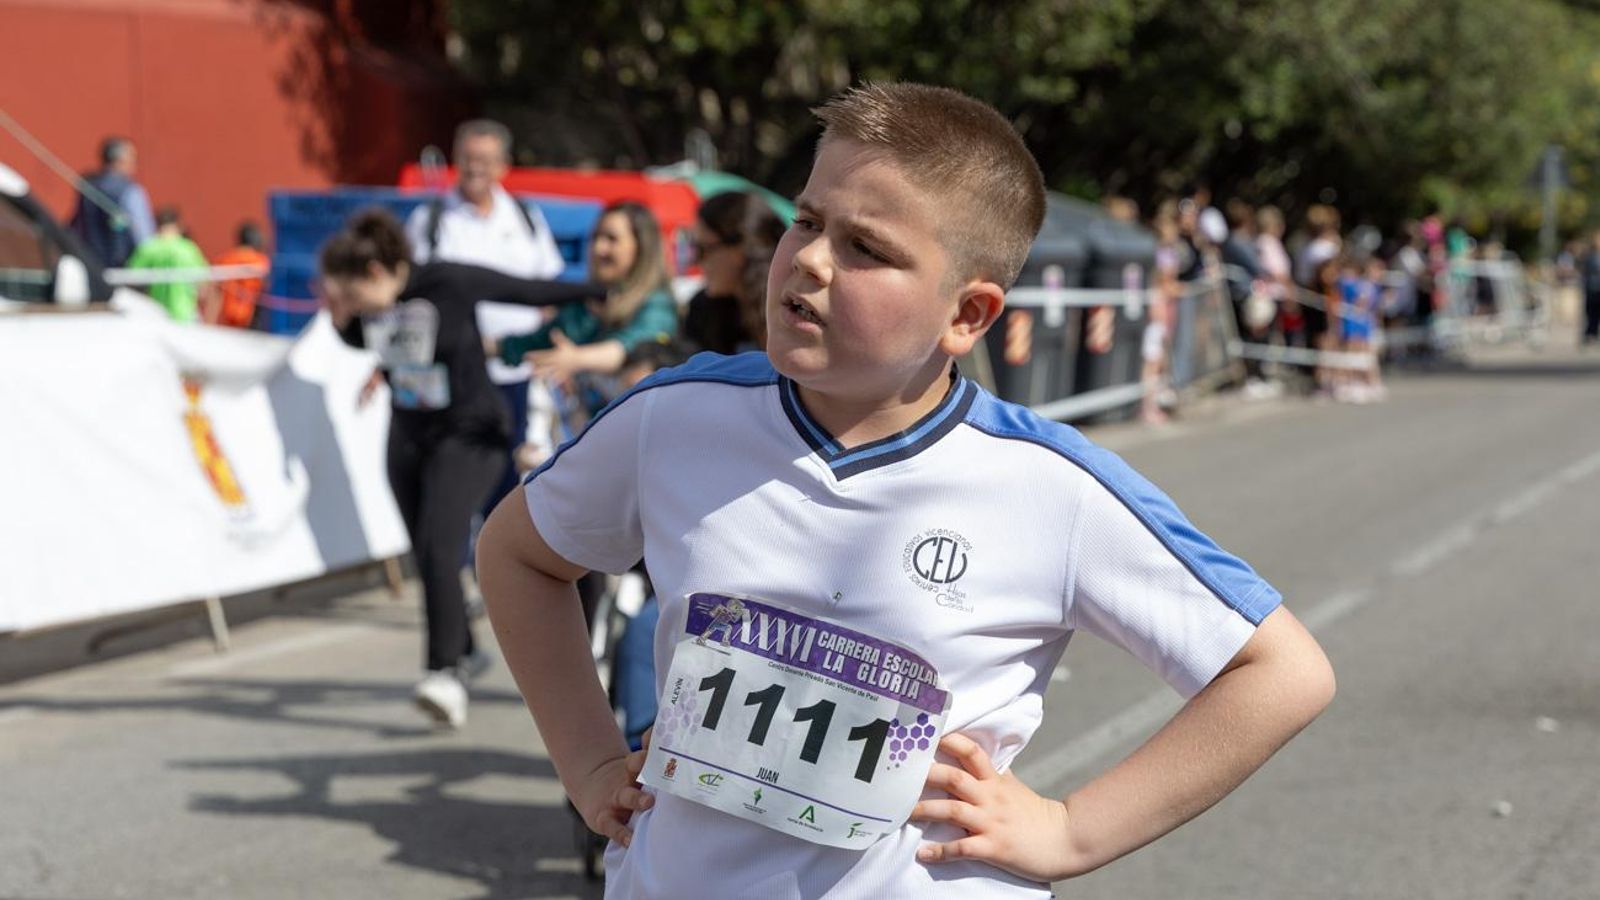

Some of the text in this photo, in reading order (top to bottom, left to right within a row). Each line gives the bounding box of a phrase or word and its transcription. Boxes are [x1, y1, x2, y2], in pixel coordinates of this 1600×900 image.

[732, 607, 817, 662] XXXVI
[817, 630, 881, 665] CARRERA
[822, 651, 920, 700] LA GLORIA
[824, 678, 836, 687] San
[837, 682, 857, 694] Vicente
[857, 689, 865, 697] de
[699, 667, 891, 784] 1111
[756, 767, 780, 784] JUAN
